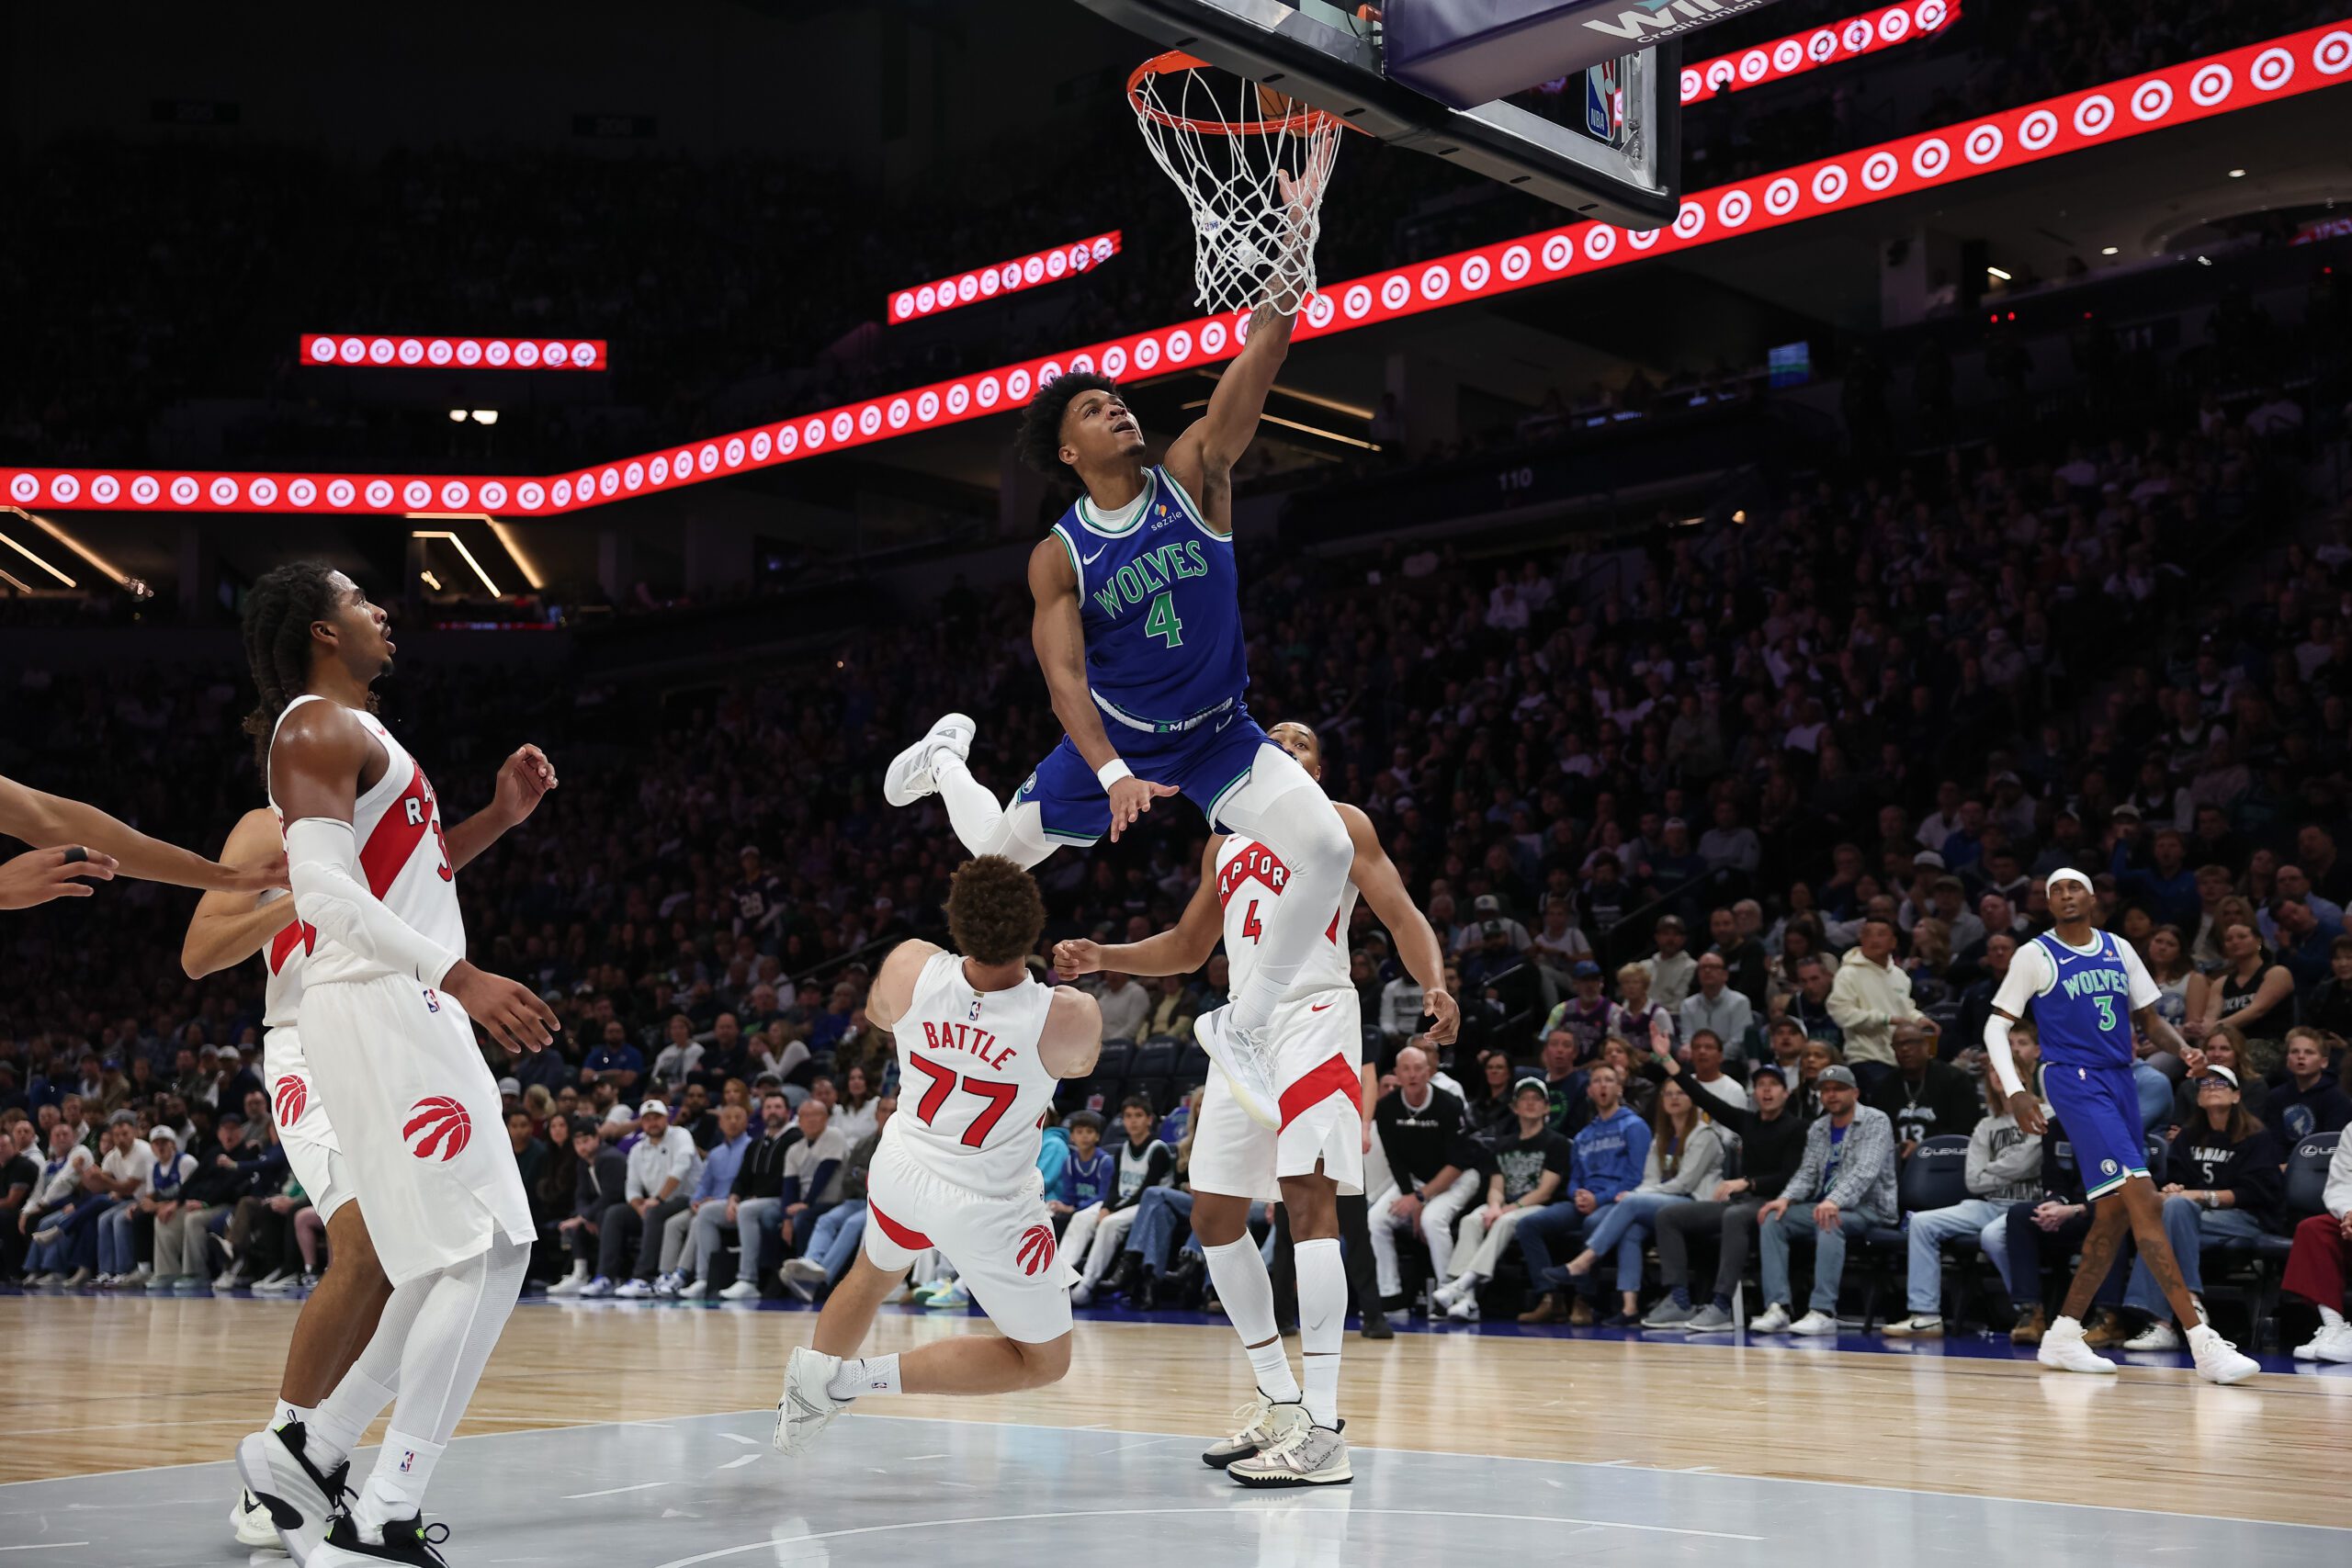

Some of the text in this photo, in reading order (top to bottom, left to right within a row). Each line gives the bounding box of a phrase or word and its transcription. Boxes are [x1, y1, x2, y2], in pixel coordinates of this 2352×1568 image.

[1637, 0, 1763, 43] Credit Union
[1589, 107, 1606, 131] NBA
[1498, 467, 1533, 491] 110
[1150, 511, 1182, 532] sezzle
[1092, 539, 1208, 621] WOLVES
[1145, 590, 1184, 649] 4
[1218, 851, 1284, 905] APTOR
[1242, 898, 1262, 946] 4
[2061, 968, 2130, 1001] WOLVES
[2092, 995, 2117, 1032] 3
[922, 1021, 1017, 1072] BATTLE
[910, 1050, 1019, 1149] 77
[2201, 1161, 2215, 1185] 5
